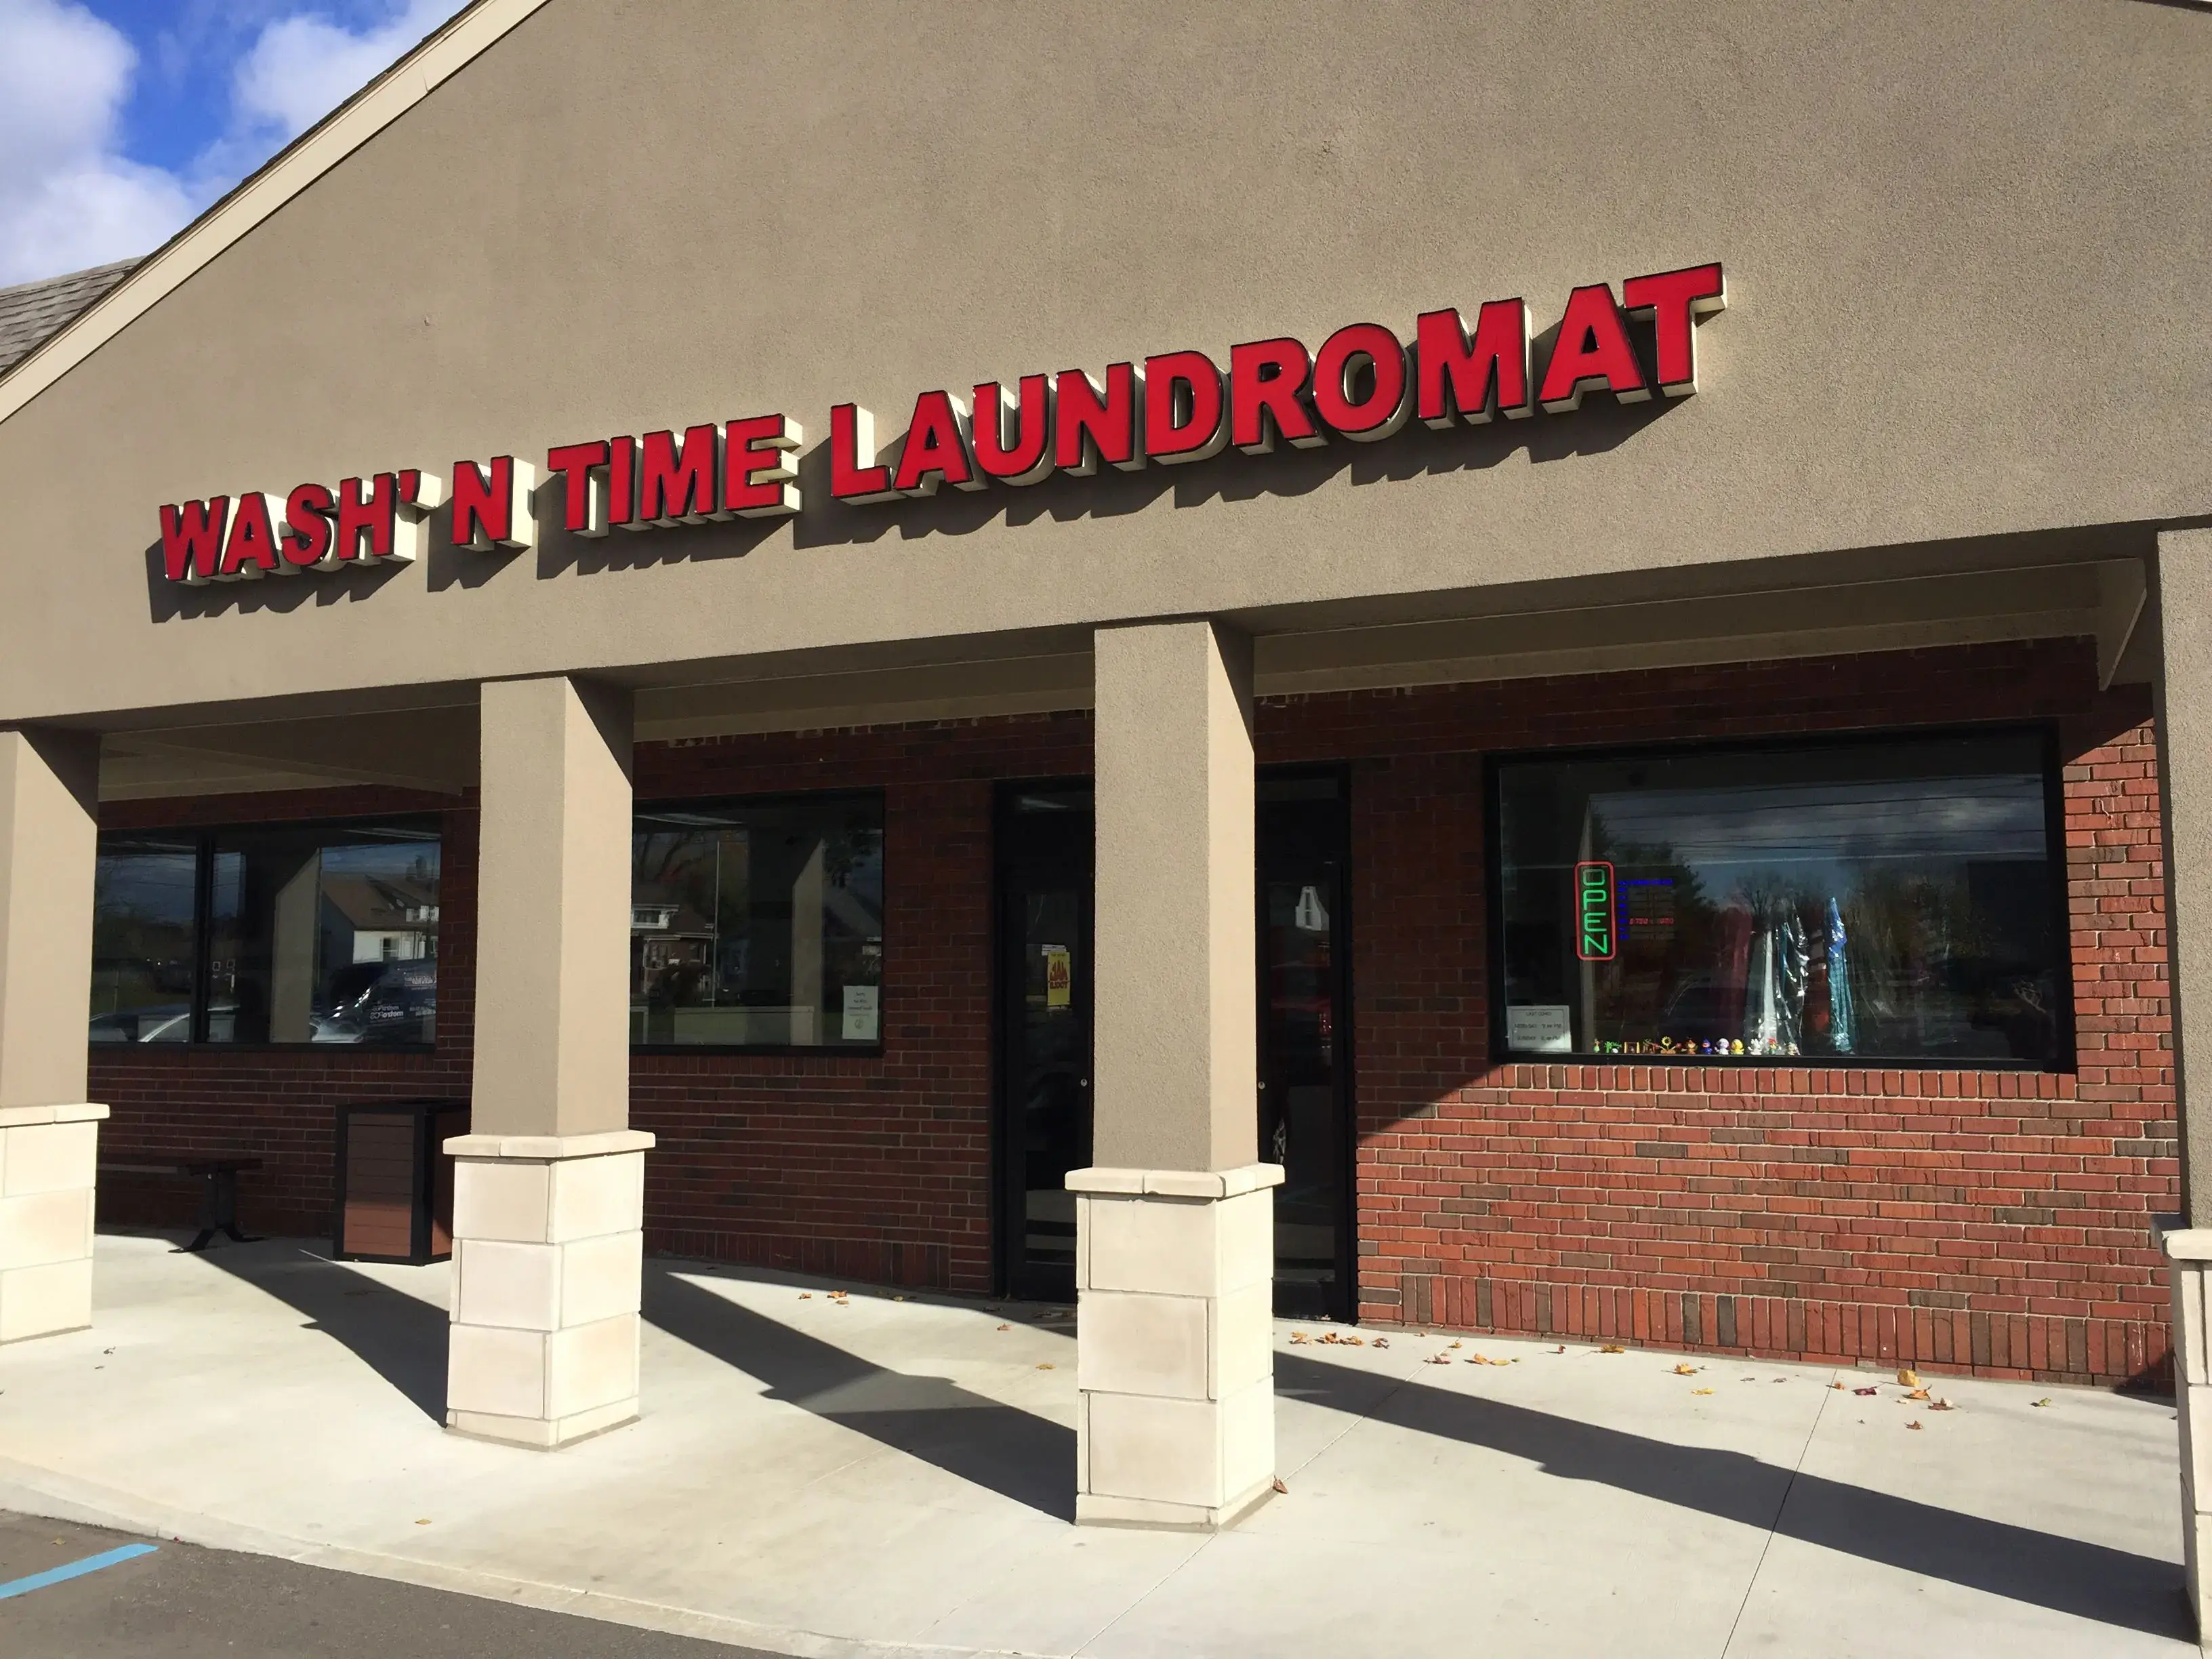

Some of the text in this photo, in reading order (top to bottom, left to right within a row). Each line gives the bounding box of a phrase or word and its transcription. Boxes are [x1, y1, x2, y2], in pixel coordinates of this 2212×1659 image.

[159, 263, 1722, 581] WASH' N TIME LAUNDROMAT
[1582, 868, 1607, 954] OPEN
